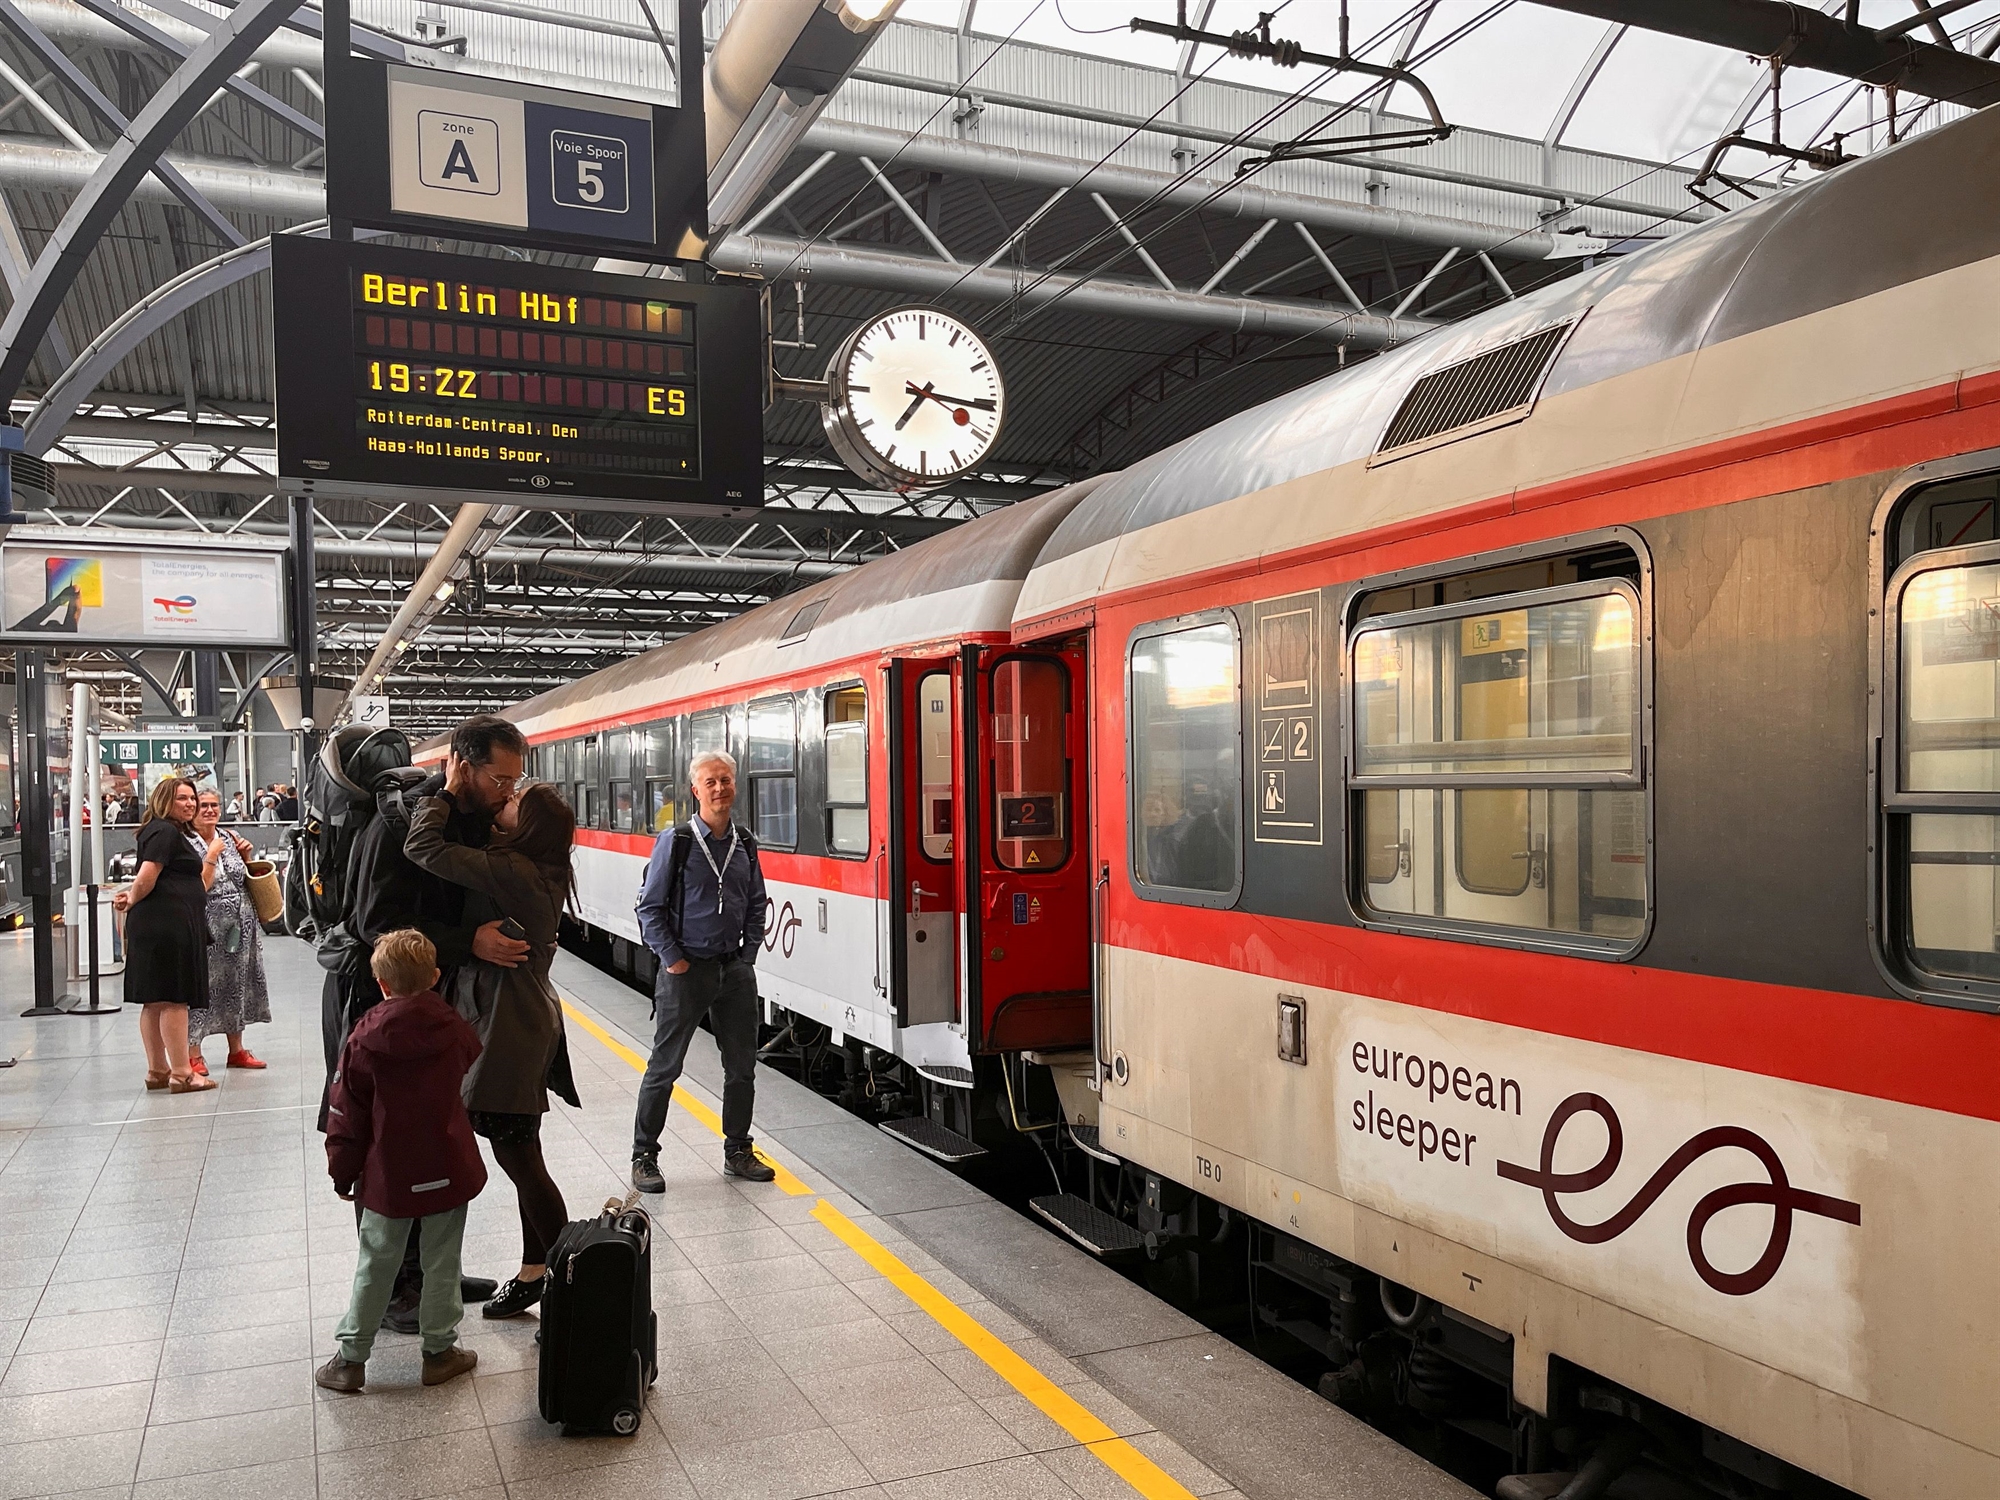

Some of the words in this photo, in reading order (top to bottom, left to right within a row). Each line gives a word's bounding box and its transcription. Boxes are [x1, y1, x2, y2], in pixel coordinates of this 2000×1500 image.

[442, 122, 475, 135] zone
[555, 139, 582, 154] Voie
[587, 145, 623, 160] Spoor
[441, 139, 479, 184] A
[578, 160, 604, 203] 5
[363, 273, 496, 316] Berlin
[520, 291, 578, 325] Hbf
[370, 361, 477, 399] 19:22
[647, 387, 686, 417] ES
[552, 423, 578, 439] Den
[368, 437, 490, 460] Haag-Hollands
[725, 490, 742, 498] AEG
[167, 570, 203, 578] company
[1294, 721, 1308, 756] 2
[1021, 803, 1036, 823] 2
[1352, 1041, 1521, 1116] european
[1352, 1089, 1477, 1167] sleeper
[1196, 1156, 1212, 1178] TB
